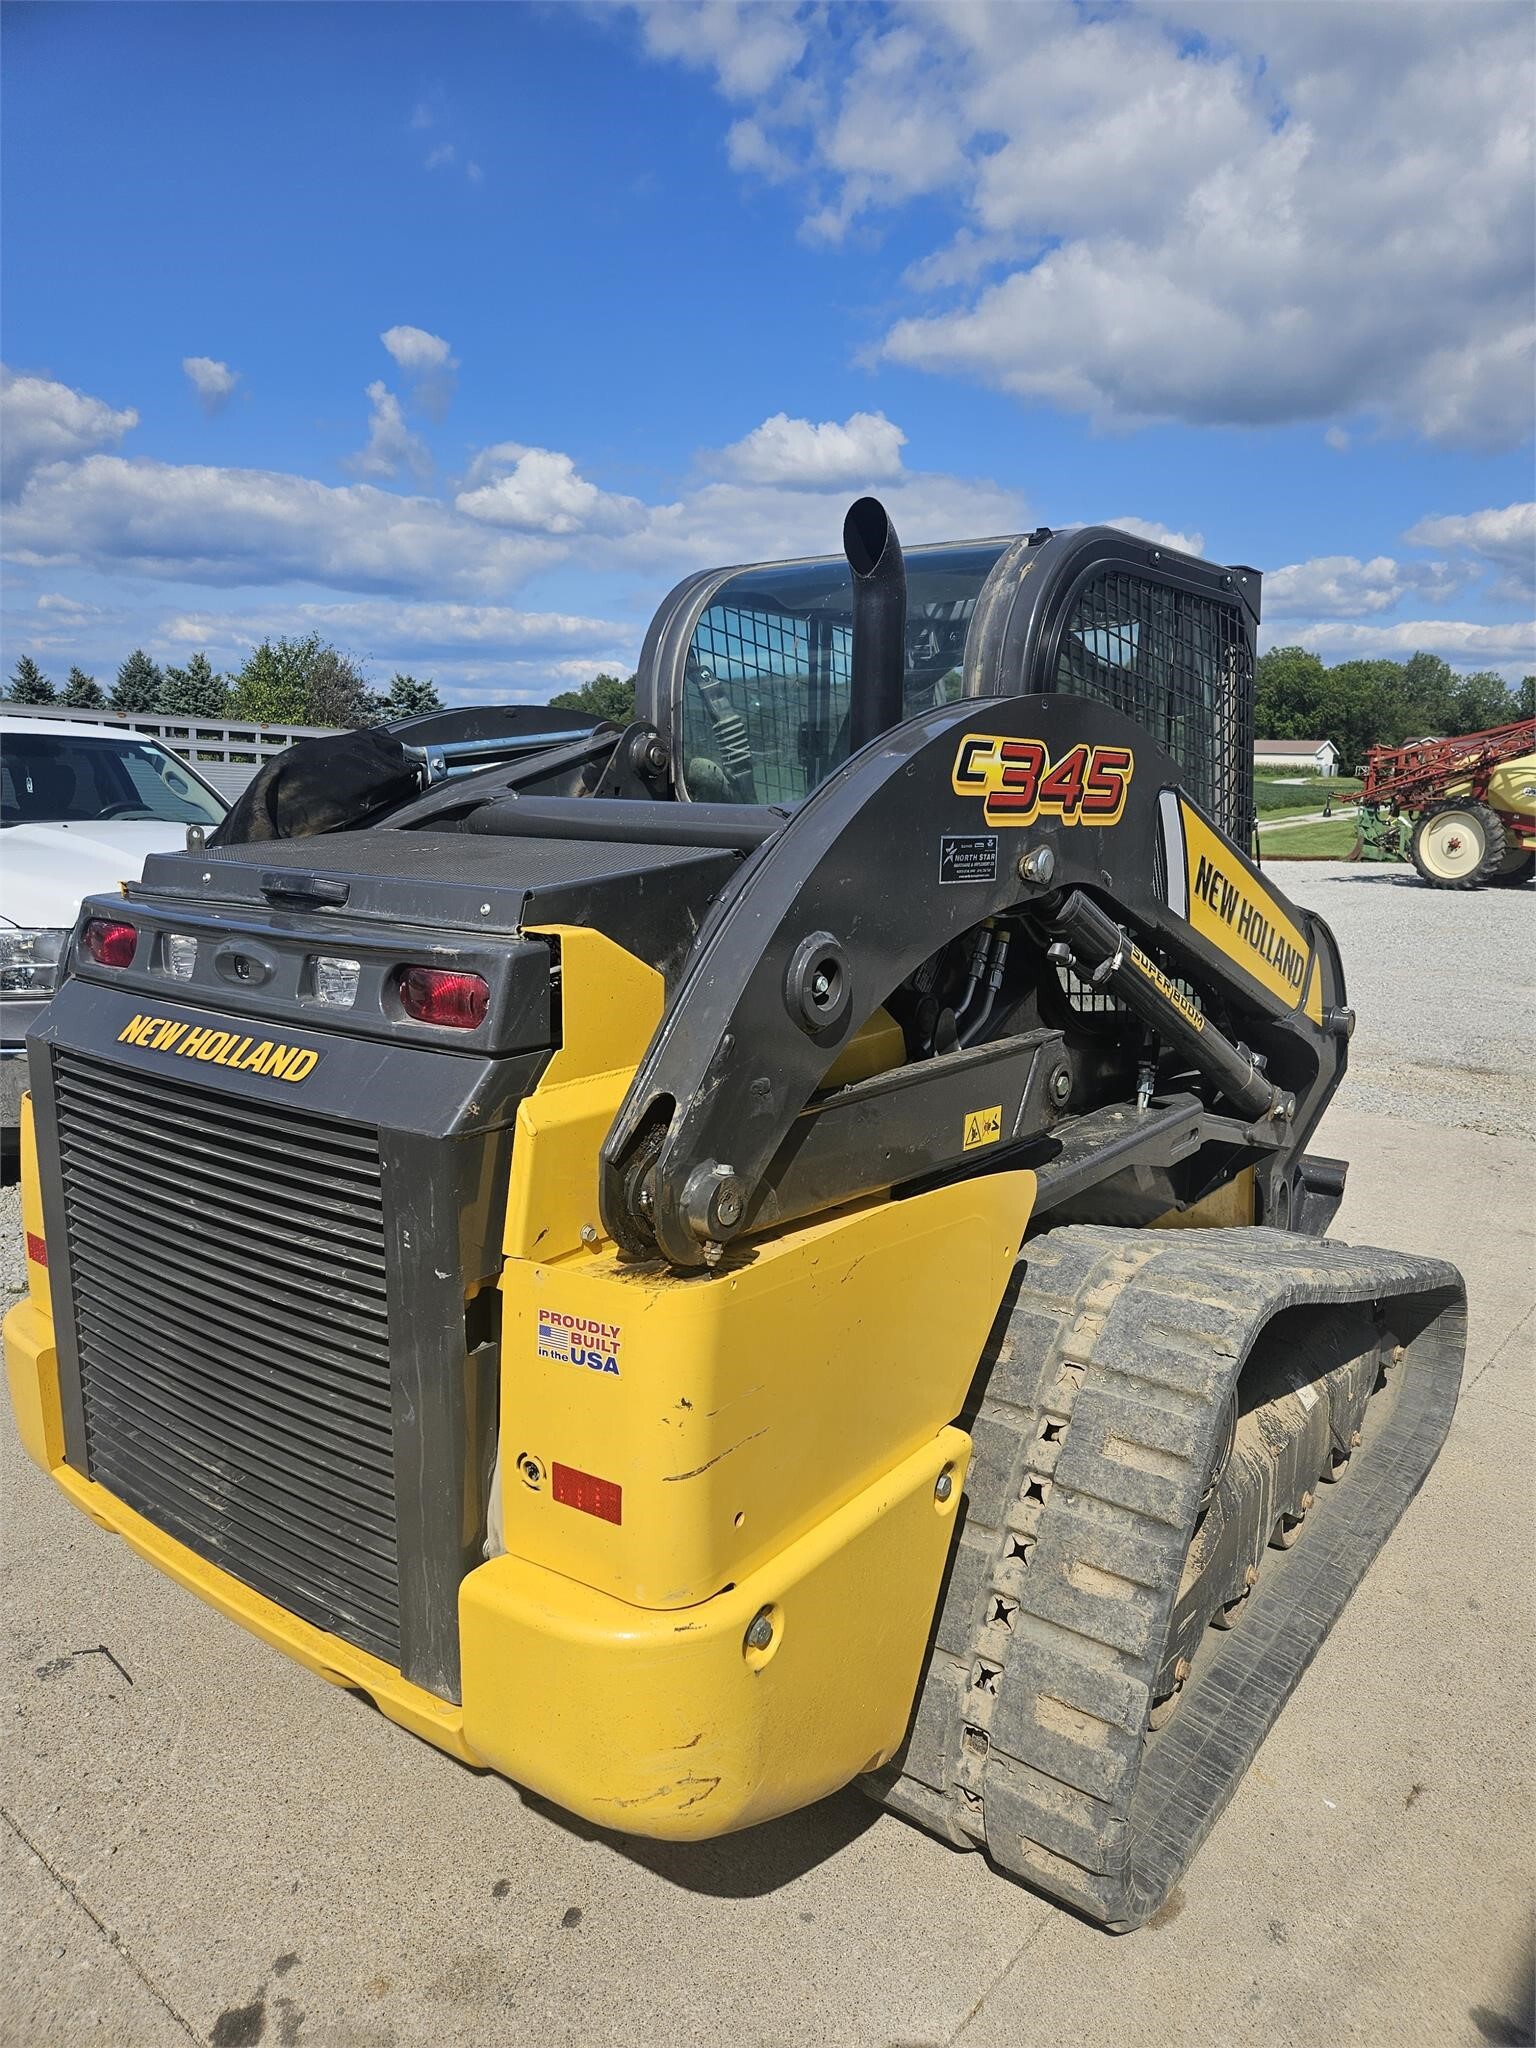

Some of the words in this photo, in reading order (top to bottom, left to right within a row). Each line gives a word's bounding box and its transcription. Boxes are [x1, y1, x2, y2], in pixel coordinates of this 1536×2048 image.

[954, 736, 1134, 826] C345
[955, 854, 978, 862] NORTH
[979, 853, 996, 861] STAR
[1194, 854, 1240, 926] NEW
[1237, 898, 1305, 989] HOLLAND
[117, 1014, 190, 1051] NEW
[175, 1026, 319, 1082] HOLLAND
[539, 1309, 620, 1339] PROUDLY
[570, 1332, 620, 1355] BUILT
[538, 1346, 549, 1357] in
[551, 1350, 569, 1362] the
[570, 1347, 620, 1375] USA
